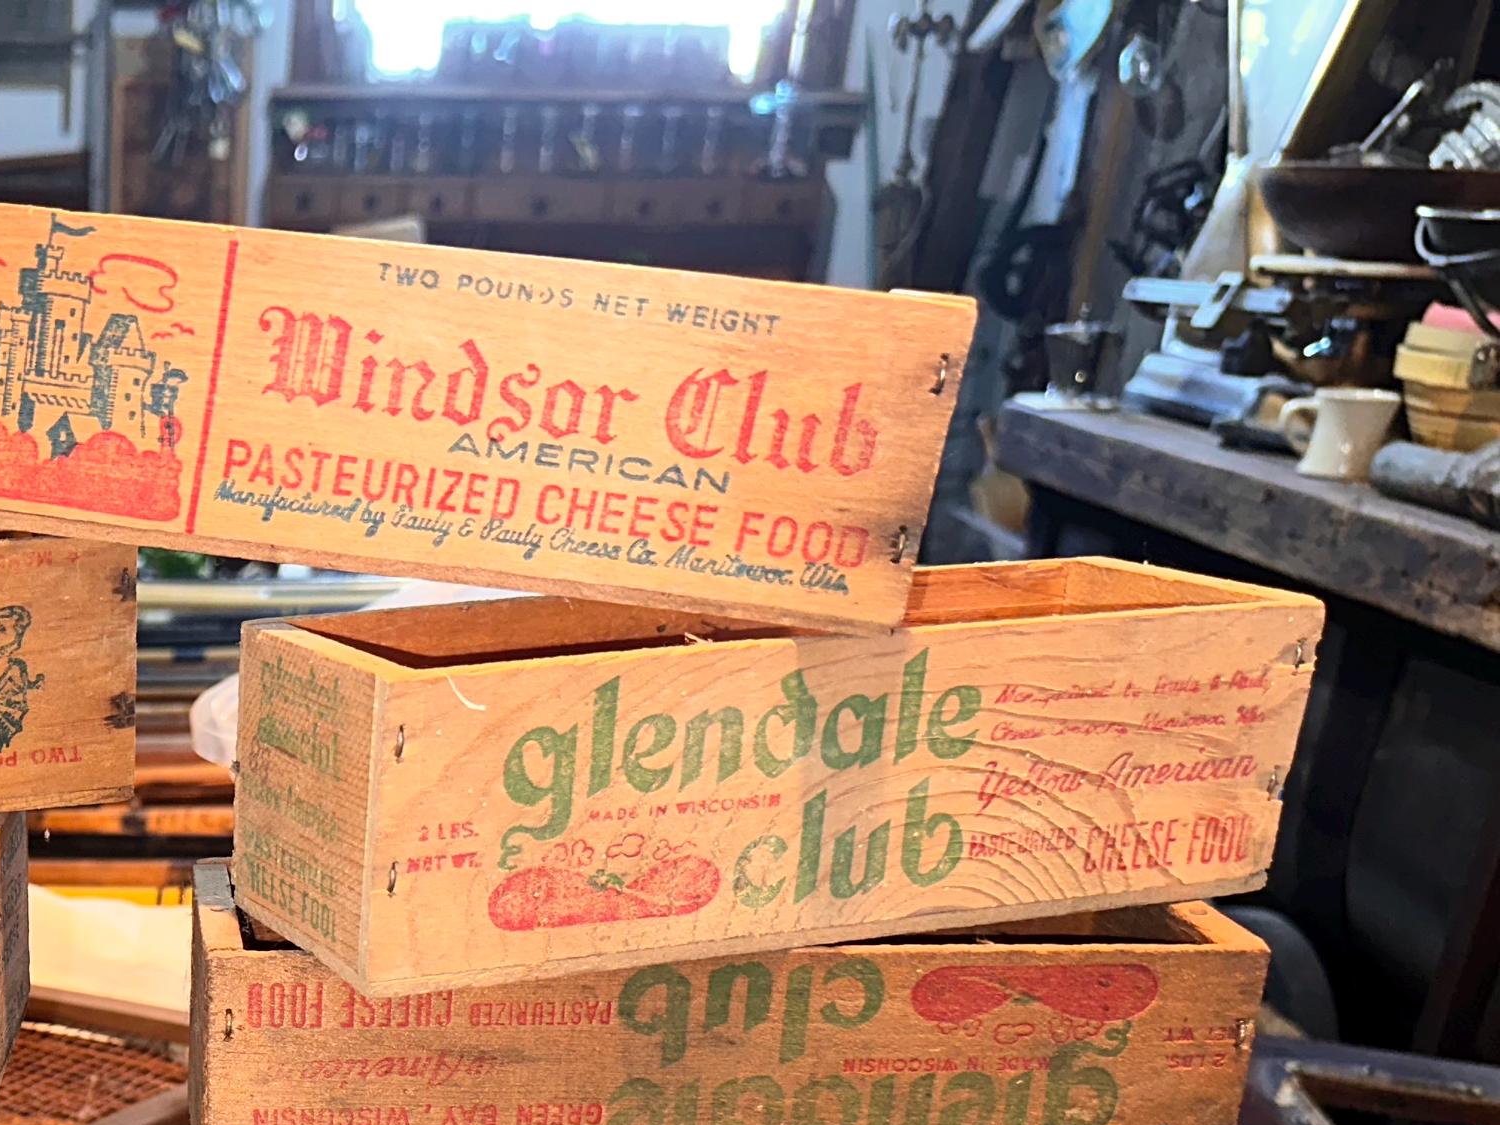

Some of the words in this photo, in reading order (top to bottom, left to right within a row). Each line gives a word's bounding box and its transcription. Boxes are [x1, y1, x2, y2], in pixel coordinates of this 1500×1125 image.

[379, 262, 440, 288] TWO
[457, 274, 573, 309] POUNDS
[593, 292, 649, 317] NET
[667, 303, 780, 336] WEIGHT
[259, 305, 640, 444] Windsor
[665, 367, 878, 476] Club
[448, 433, 730, 494] AMERICAN
[214, 479, 361, 521] Manufactured
[360, 500, 384, 537] by
[391, 504, 452, 546] Pauly
[458, 519, 475, 537] &
[480, 518, 544, 559] Pauly
[550, 525, 621, 561] Cheese
[223, 438, 521, 520] PASTEURIZED
[536, 484, 719, 547] CHEESE
[734, 511, 869, 568] FOOD
[31, 745, 82, 763] TWO
[498, 647, 982, 870] glendale
[1100, 747, 1258, 791] American
[589, 807, 638, 823] MADE
[649, 805, 668, 818] IN
[676, 793, 781, 816] WISCONSIN
[418, 826, 429, 842] 2
[732, 776, 963, 908] club
[1083, 817, 1179, 874] CHEESE
[1186, 813, 1252, 866] FOOD
[406, 856, 447, 874] NET
[247, 982, 323, 1029] FOOD
[468, 1000, 613, 1027] PASTEURIZED
[618, 957, 885, 1068] club
[841, 1058, 958, 1074] WISCONSIN
[966, 1057, 986, 1072] IN
[996, 1056, 1051, 1072] MADE
[1212, 1053, 1226, 1067] 2
